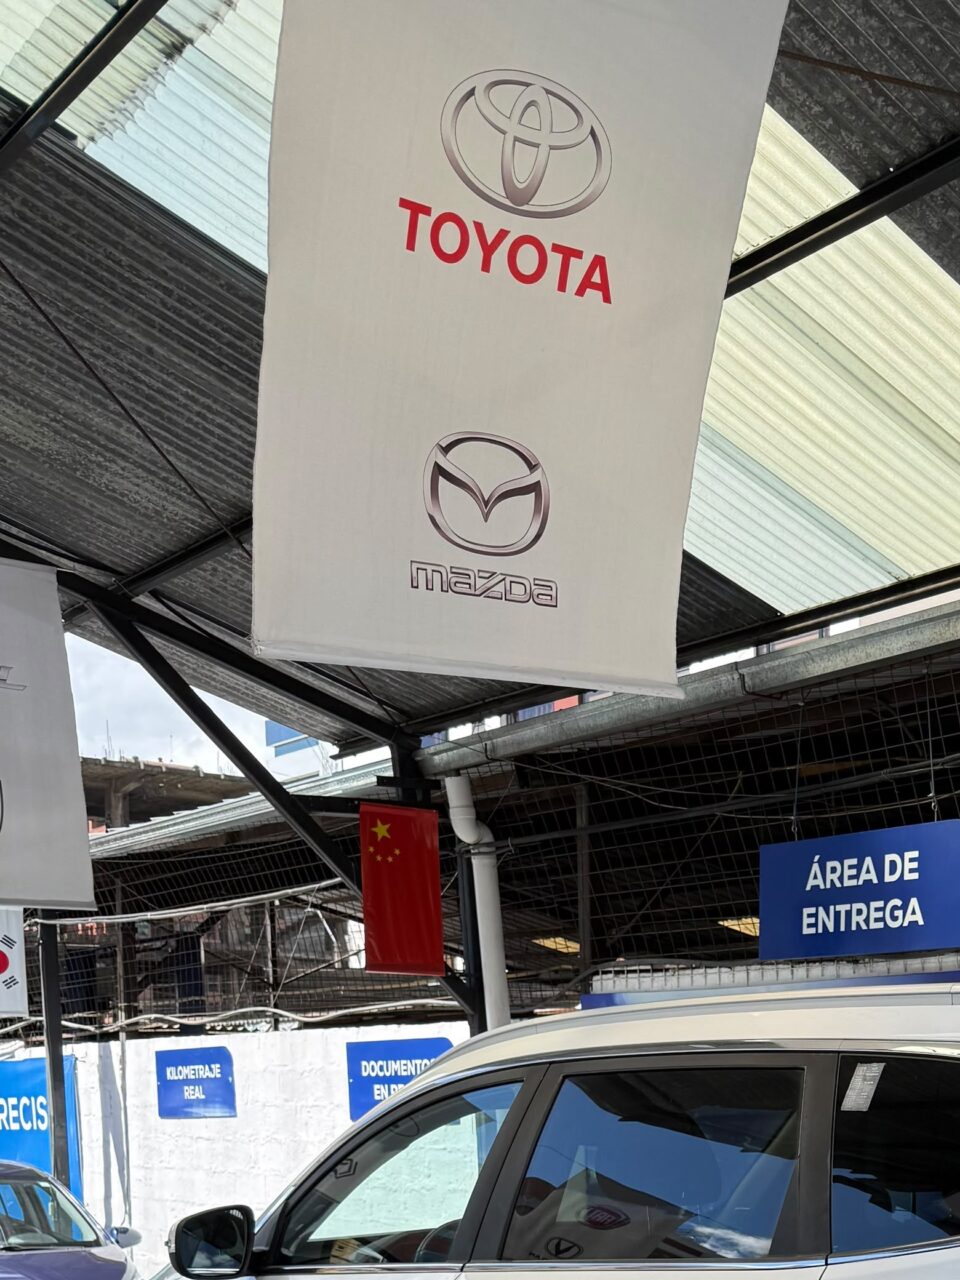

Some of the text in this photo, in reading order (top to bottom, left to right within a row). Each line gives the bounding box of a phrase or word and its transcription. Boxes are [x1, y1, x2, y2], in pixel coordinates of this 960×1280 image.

[399, 197, 612, 304] TOYOTA
[805, 850, 919, 891] ÁREA DE
[802, 897, 924, 935] ENTREGA
[166, 1063, 221, 1080] KILOMETRAJE
[361, 1058, 436, 1077] DOCUMENTO
[183, 1085, 206, 1100] REAL
[373, 1084, 389, 1100] EN
